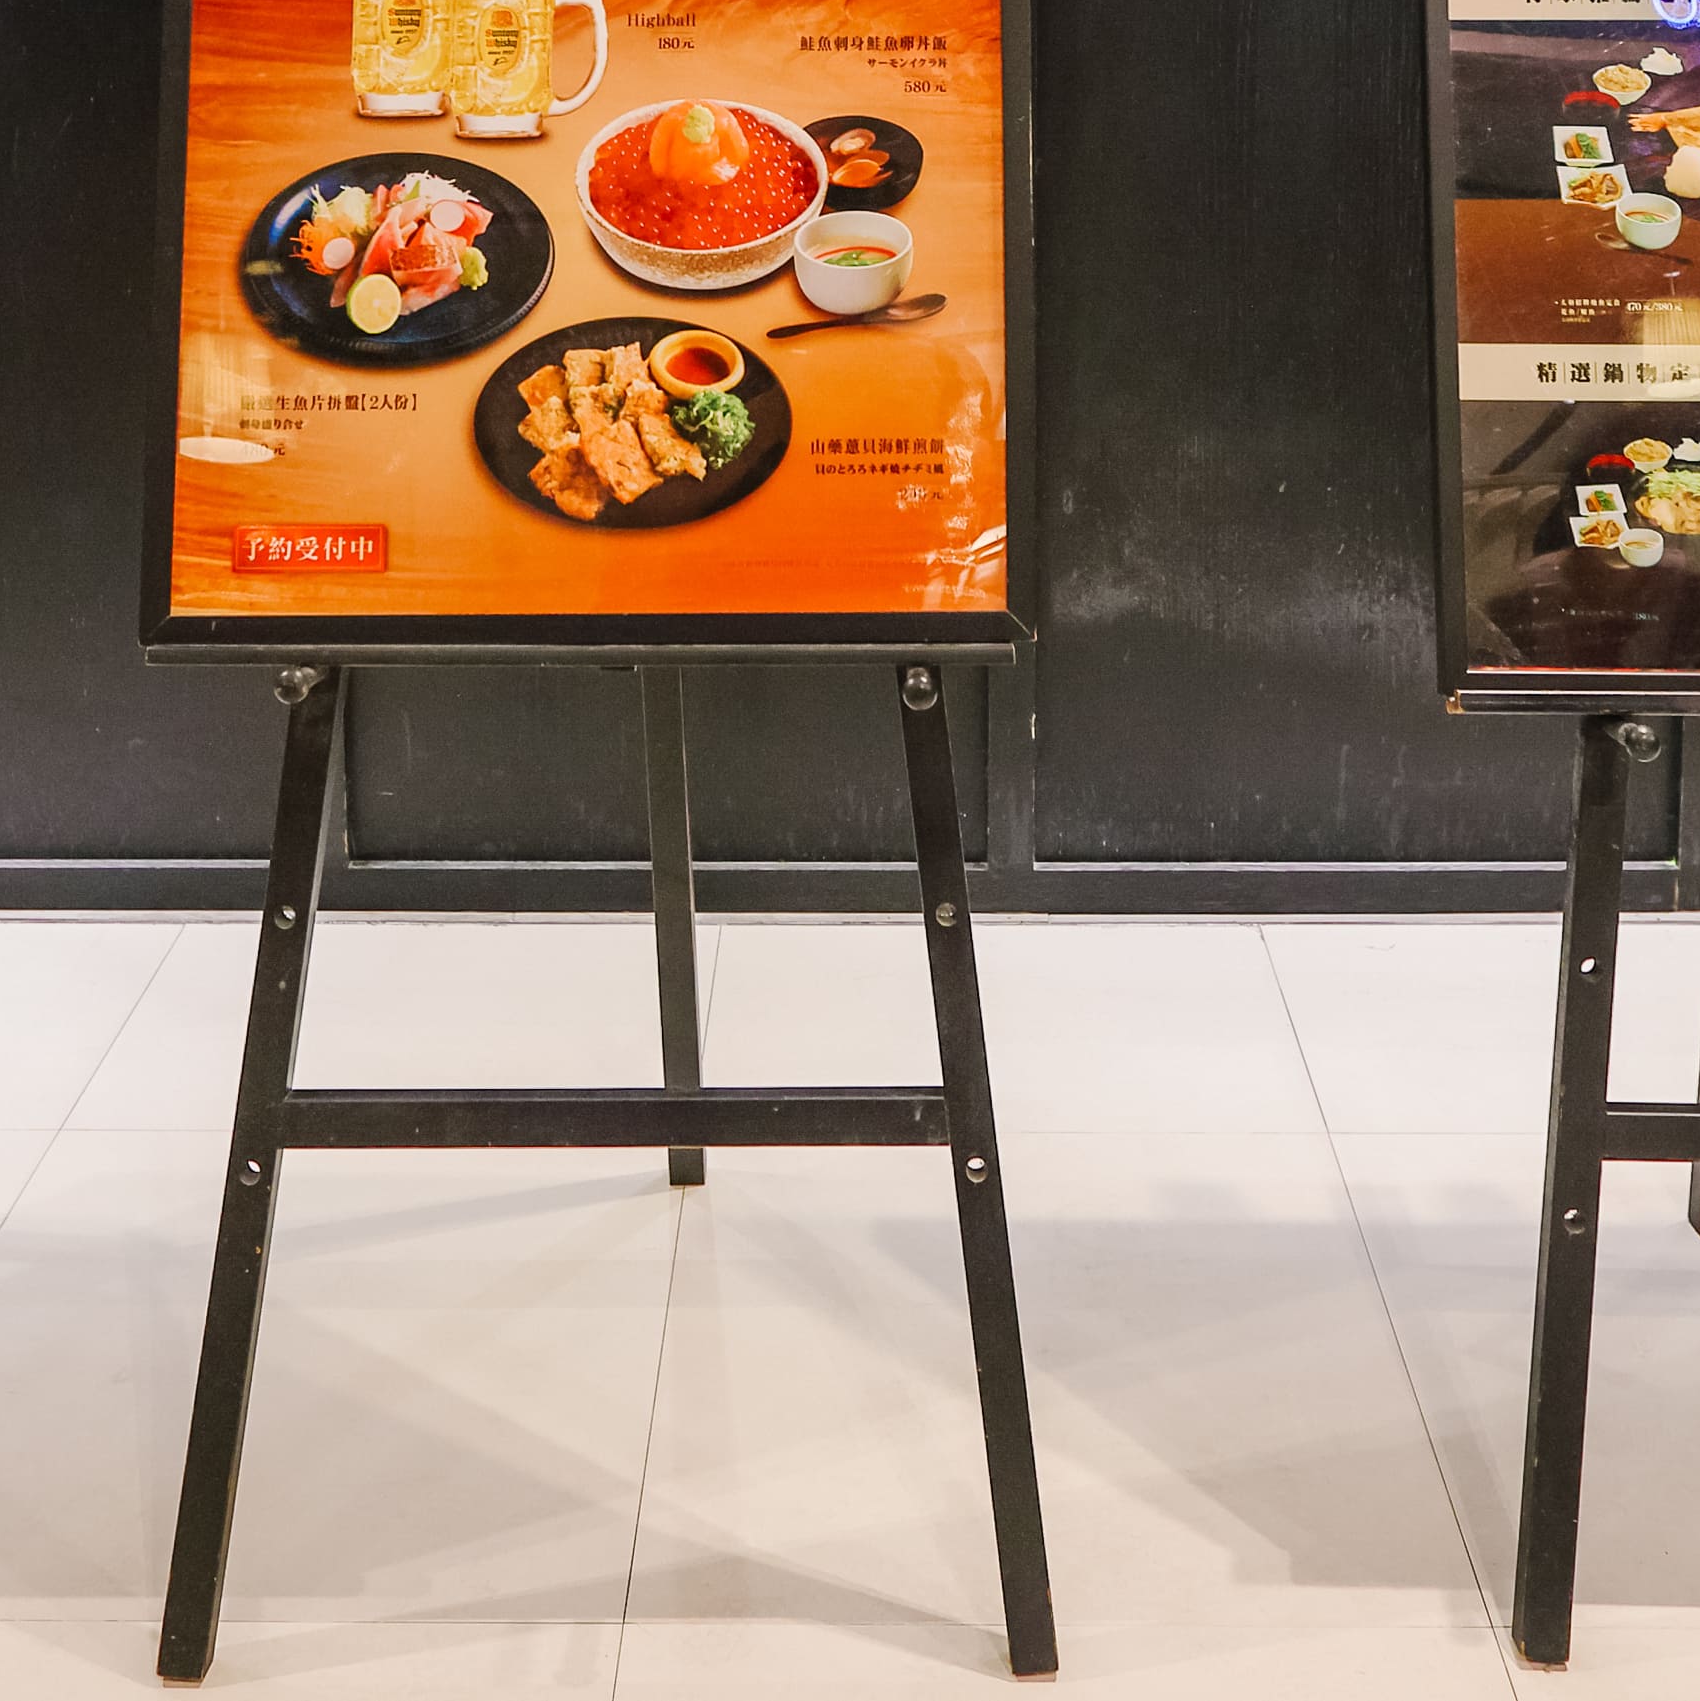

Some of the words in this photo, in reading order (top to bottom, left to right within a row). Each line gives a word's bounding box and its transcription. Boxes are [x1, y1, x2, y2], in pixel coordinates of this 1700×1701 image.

[627, 13, 697, 29] Highball
[242, 535, 374, 562] 予約受付中
